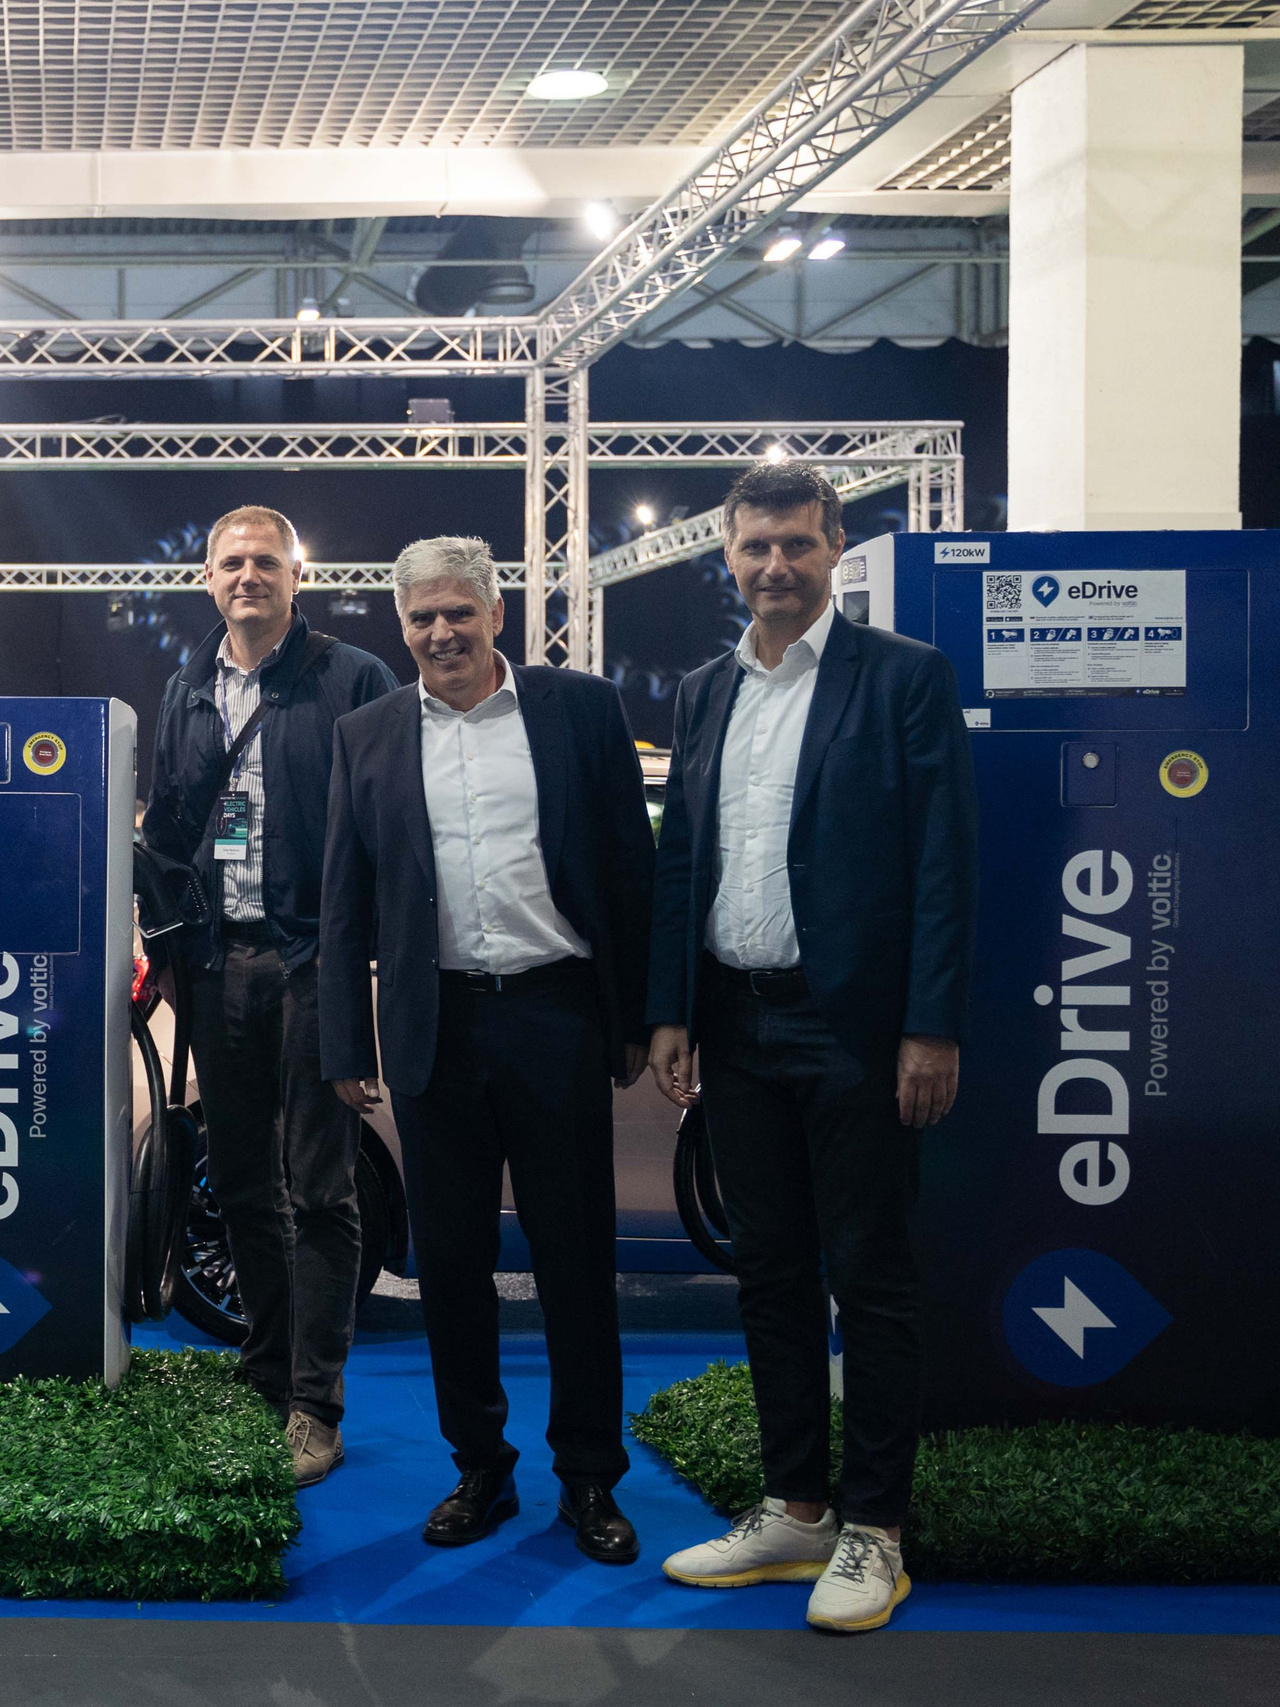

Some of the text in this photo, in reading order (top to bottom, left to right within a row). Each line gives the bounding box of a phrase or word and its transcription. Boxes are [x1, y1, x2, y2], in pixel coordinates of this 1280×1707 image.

[951, 548, 985, 557] 120kW
[1067, 580, 1138, 599] eDrive
[990, 632, 995, 640] 1
[1033, 631, 1039, 639] 2
[1091, 630, 1097, 638] 3
[1148, 630, 1154, 638] 4
[28, 734, 54, 748] EMERGENCY
[1163, 753, 1192, 769] EMERGENCY
[1144, 854, 1175, 1096] Powered by voltic
[1033, 850, 1133, 1206] eDrive
[29, 955, 51, 1138] Powered by voltic
